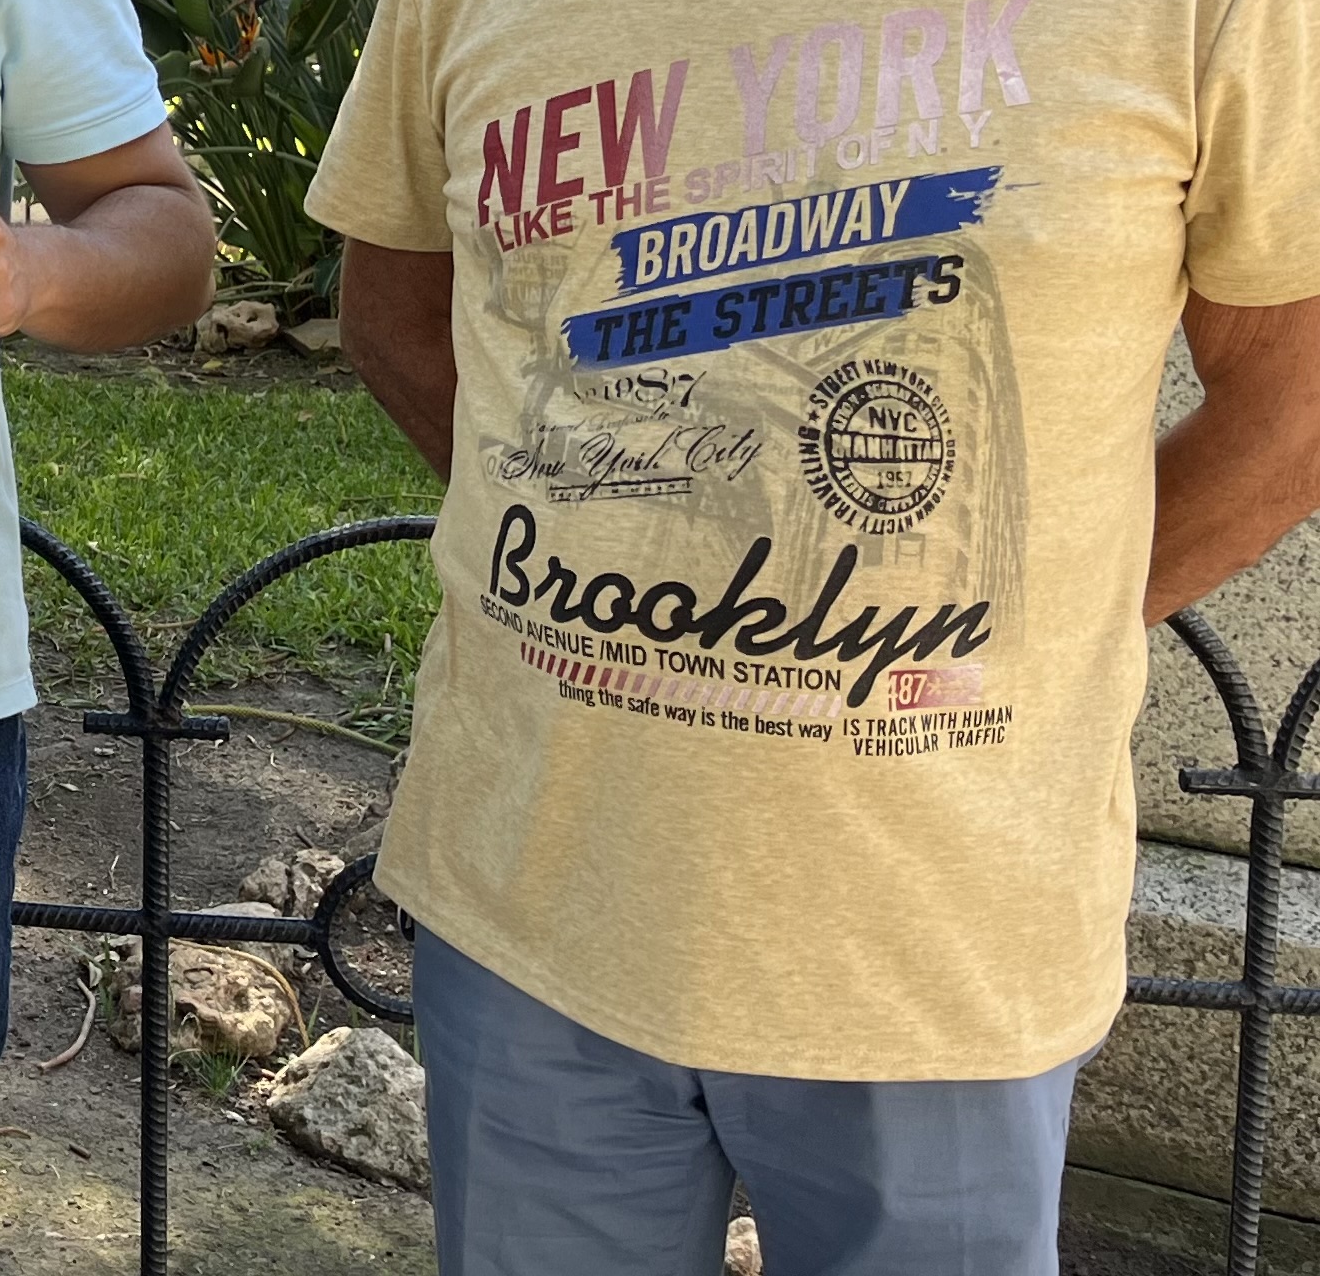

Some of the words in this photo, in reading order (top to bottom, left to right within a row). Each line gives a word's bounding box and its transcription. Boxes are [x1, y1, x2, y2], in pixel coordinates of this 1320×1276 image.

[477, 58, 690, 228] NEW
[493, 199, 574, 253] LIKE
[588, 175, 671, 225] THE
[684, 140, 826, 205] SPIRIT
[836, 126, 897, 170] OF
[635, 179, 911, 286] BROADWAY
[594, 299, 693, 362] THE
[712, 254, 965, 339] STREETS
[809, 361, 861, 410] STREET
[863, 358, 898, 377] NEW
[900, 366, 933, 397] YORK
[868, 406, 918, 433] NYC
[500, 438, 566, 480] New
[674, 424, 762, 481] City
[797, 425, 858, 527] TRAVELING
[480, 593, 523, 634] SECOND
[526, 618, 595, 659] AVENUE
[654, 647, 726, 680] TOWN
[733, 661, 842, 691] STATION
[488, 503, 991, 708] Brooklyn
[558, 679, 596, 707] thing
[597, 686, 623, 709] the
[627, 696, 660, 717] safe
[664, 704, 696, 727] way
[701, 706, 715, 727] is
[722, 709, 749, 732] the
[755, 714, 793, 738] best
[798, 721, 833, 742] way
[843, 718, 860, 736] IS
[868, 715, 918, 737] TRACK
[920, 712, 957, 732] WITH
[962, 705, 1013, 729] HUMAN
[853, 734, 939, 757] VEHICULAR
[948, 726, 1006, 749] TRAFFIC
